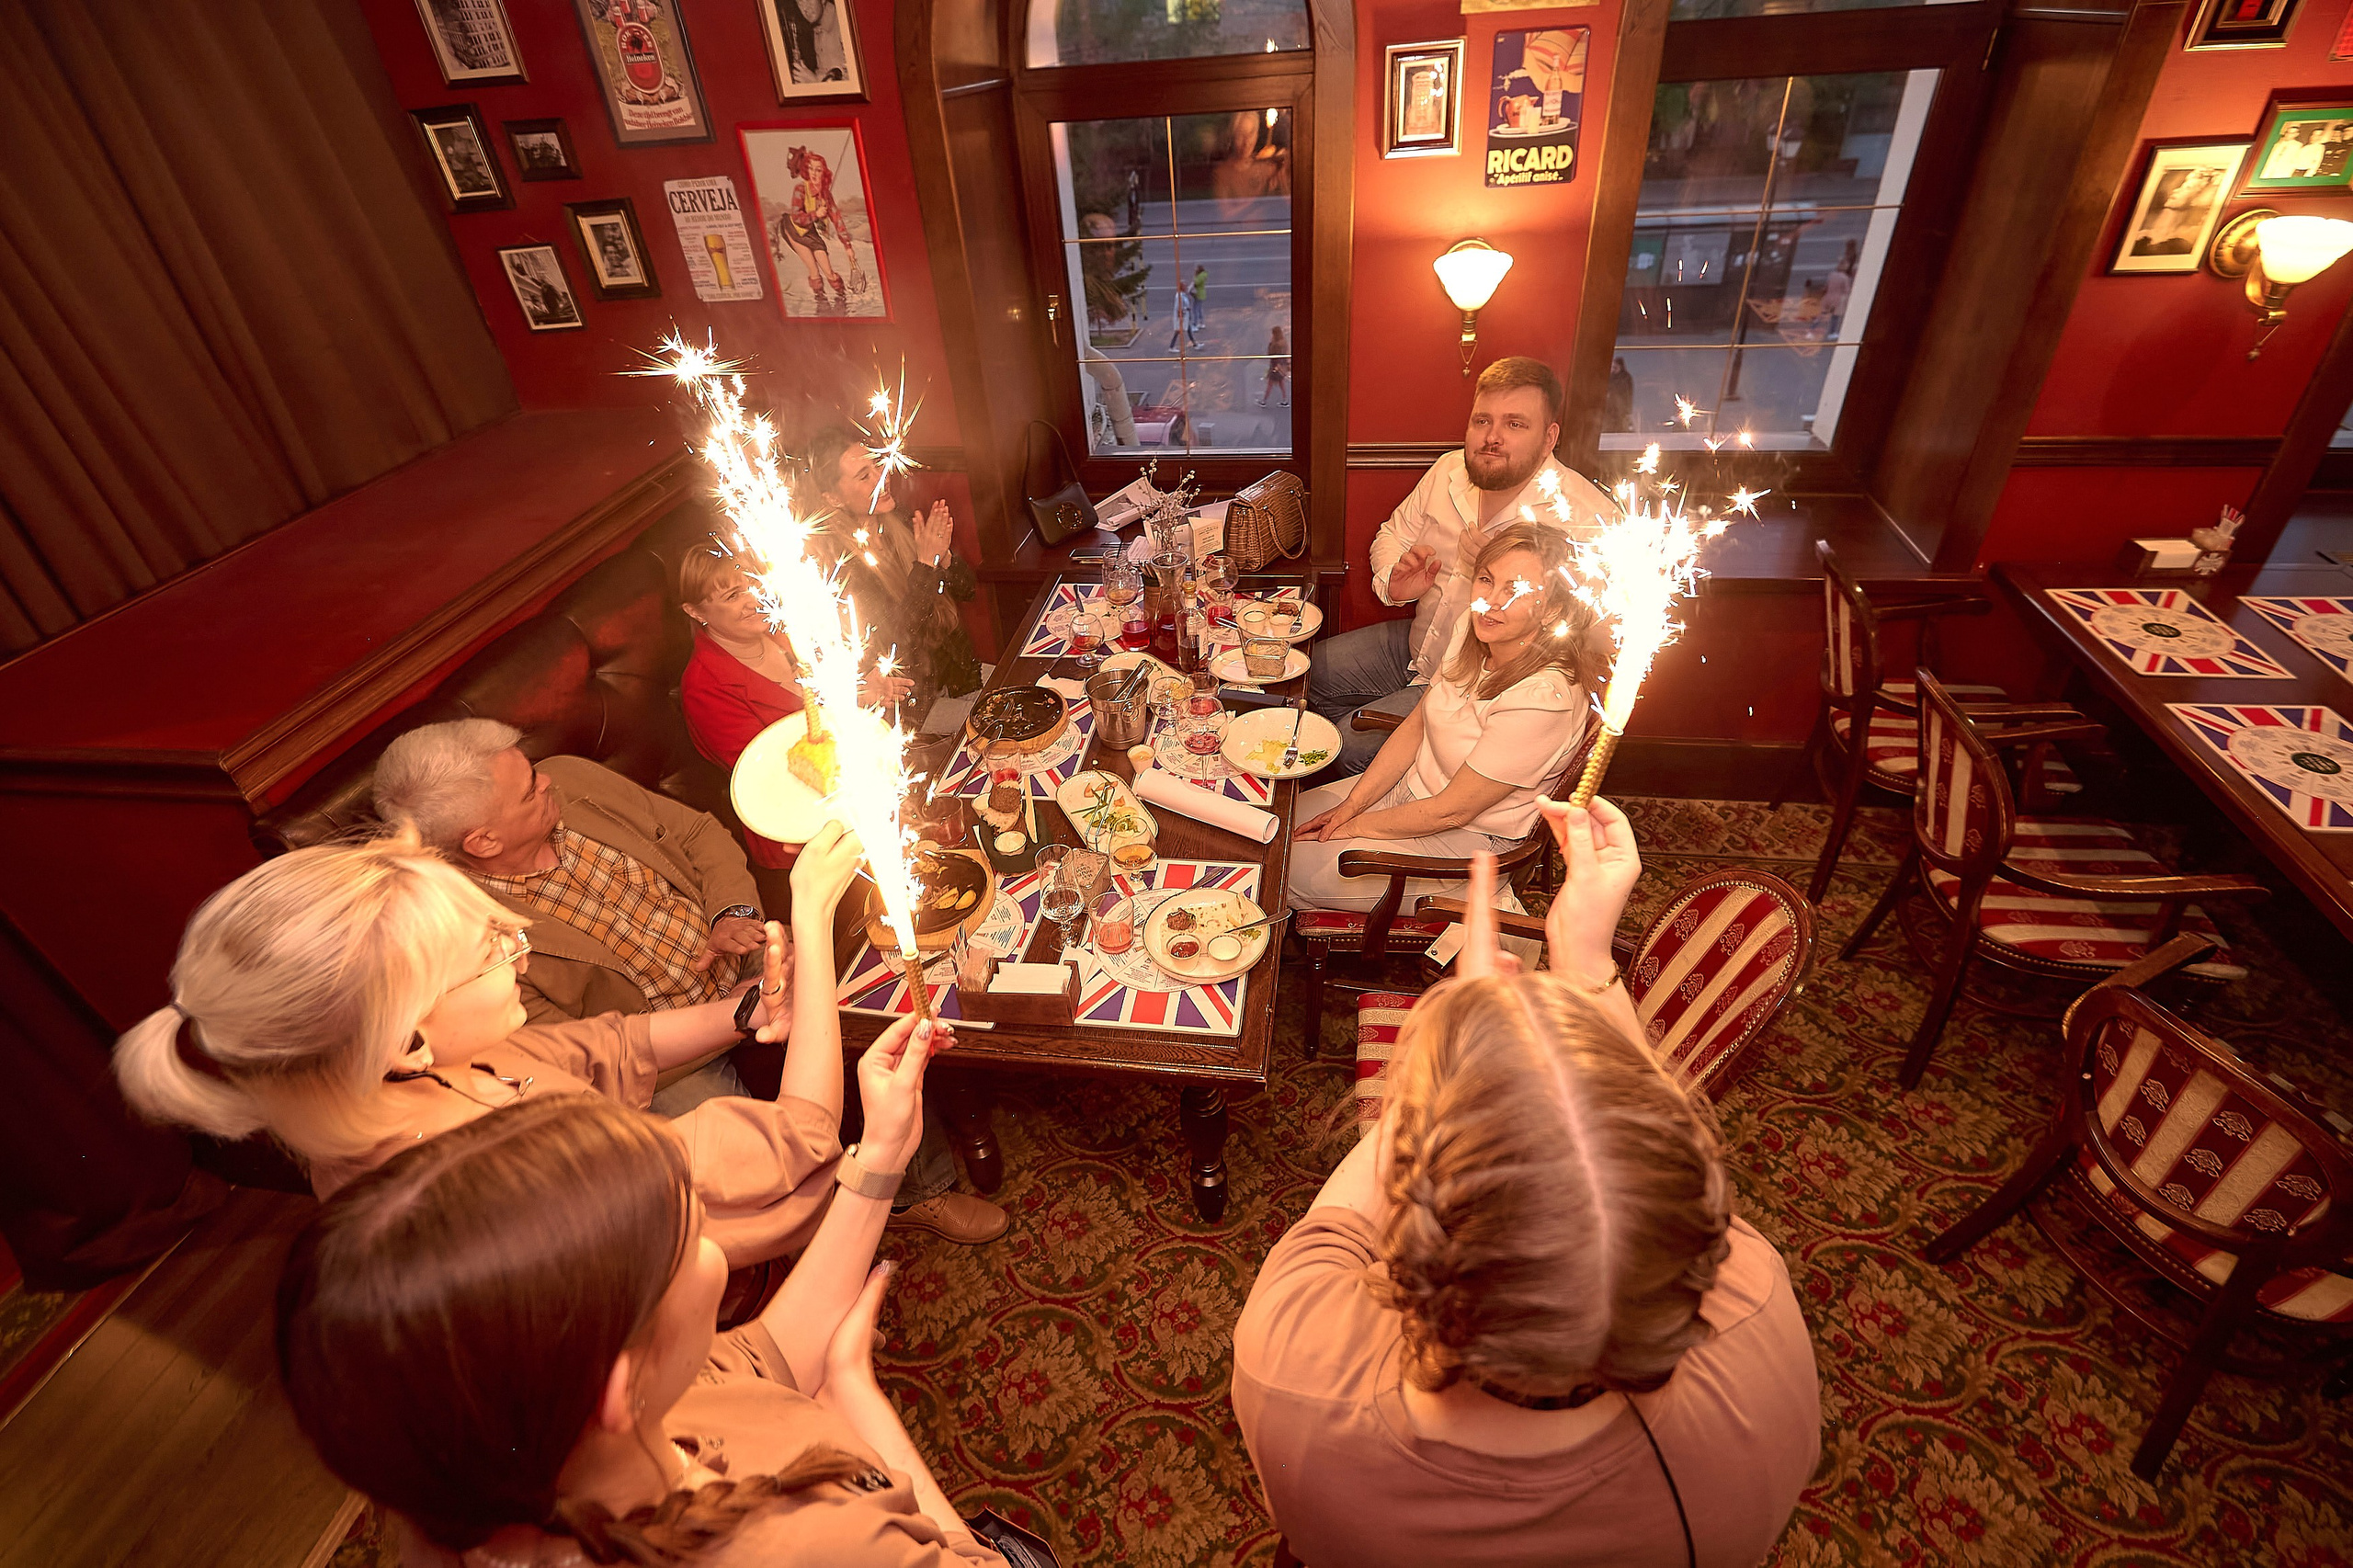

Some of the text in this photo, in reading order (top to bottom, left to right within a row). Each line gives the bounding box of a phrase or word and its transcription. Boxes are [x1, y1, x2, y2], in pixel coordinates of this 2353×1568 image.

[626, 53, 655, 63] Heineken
[1487, 144, 1574, 175] RICARD
[669, 188, 738, 213] CERVEJA
